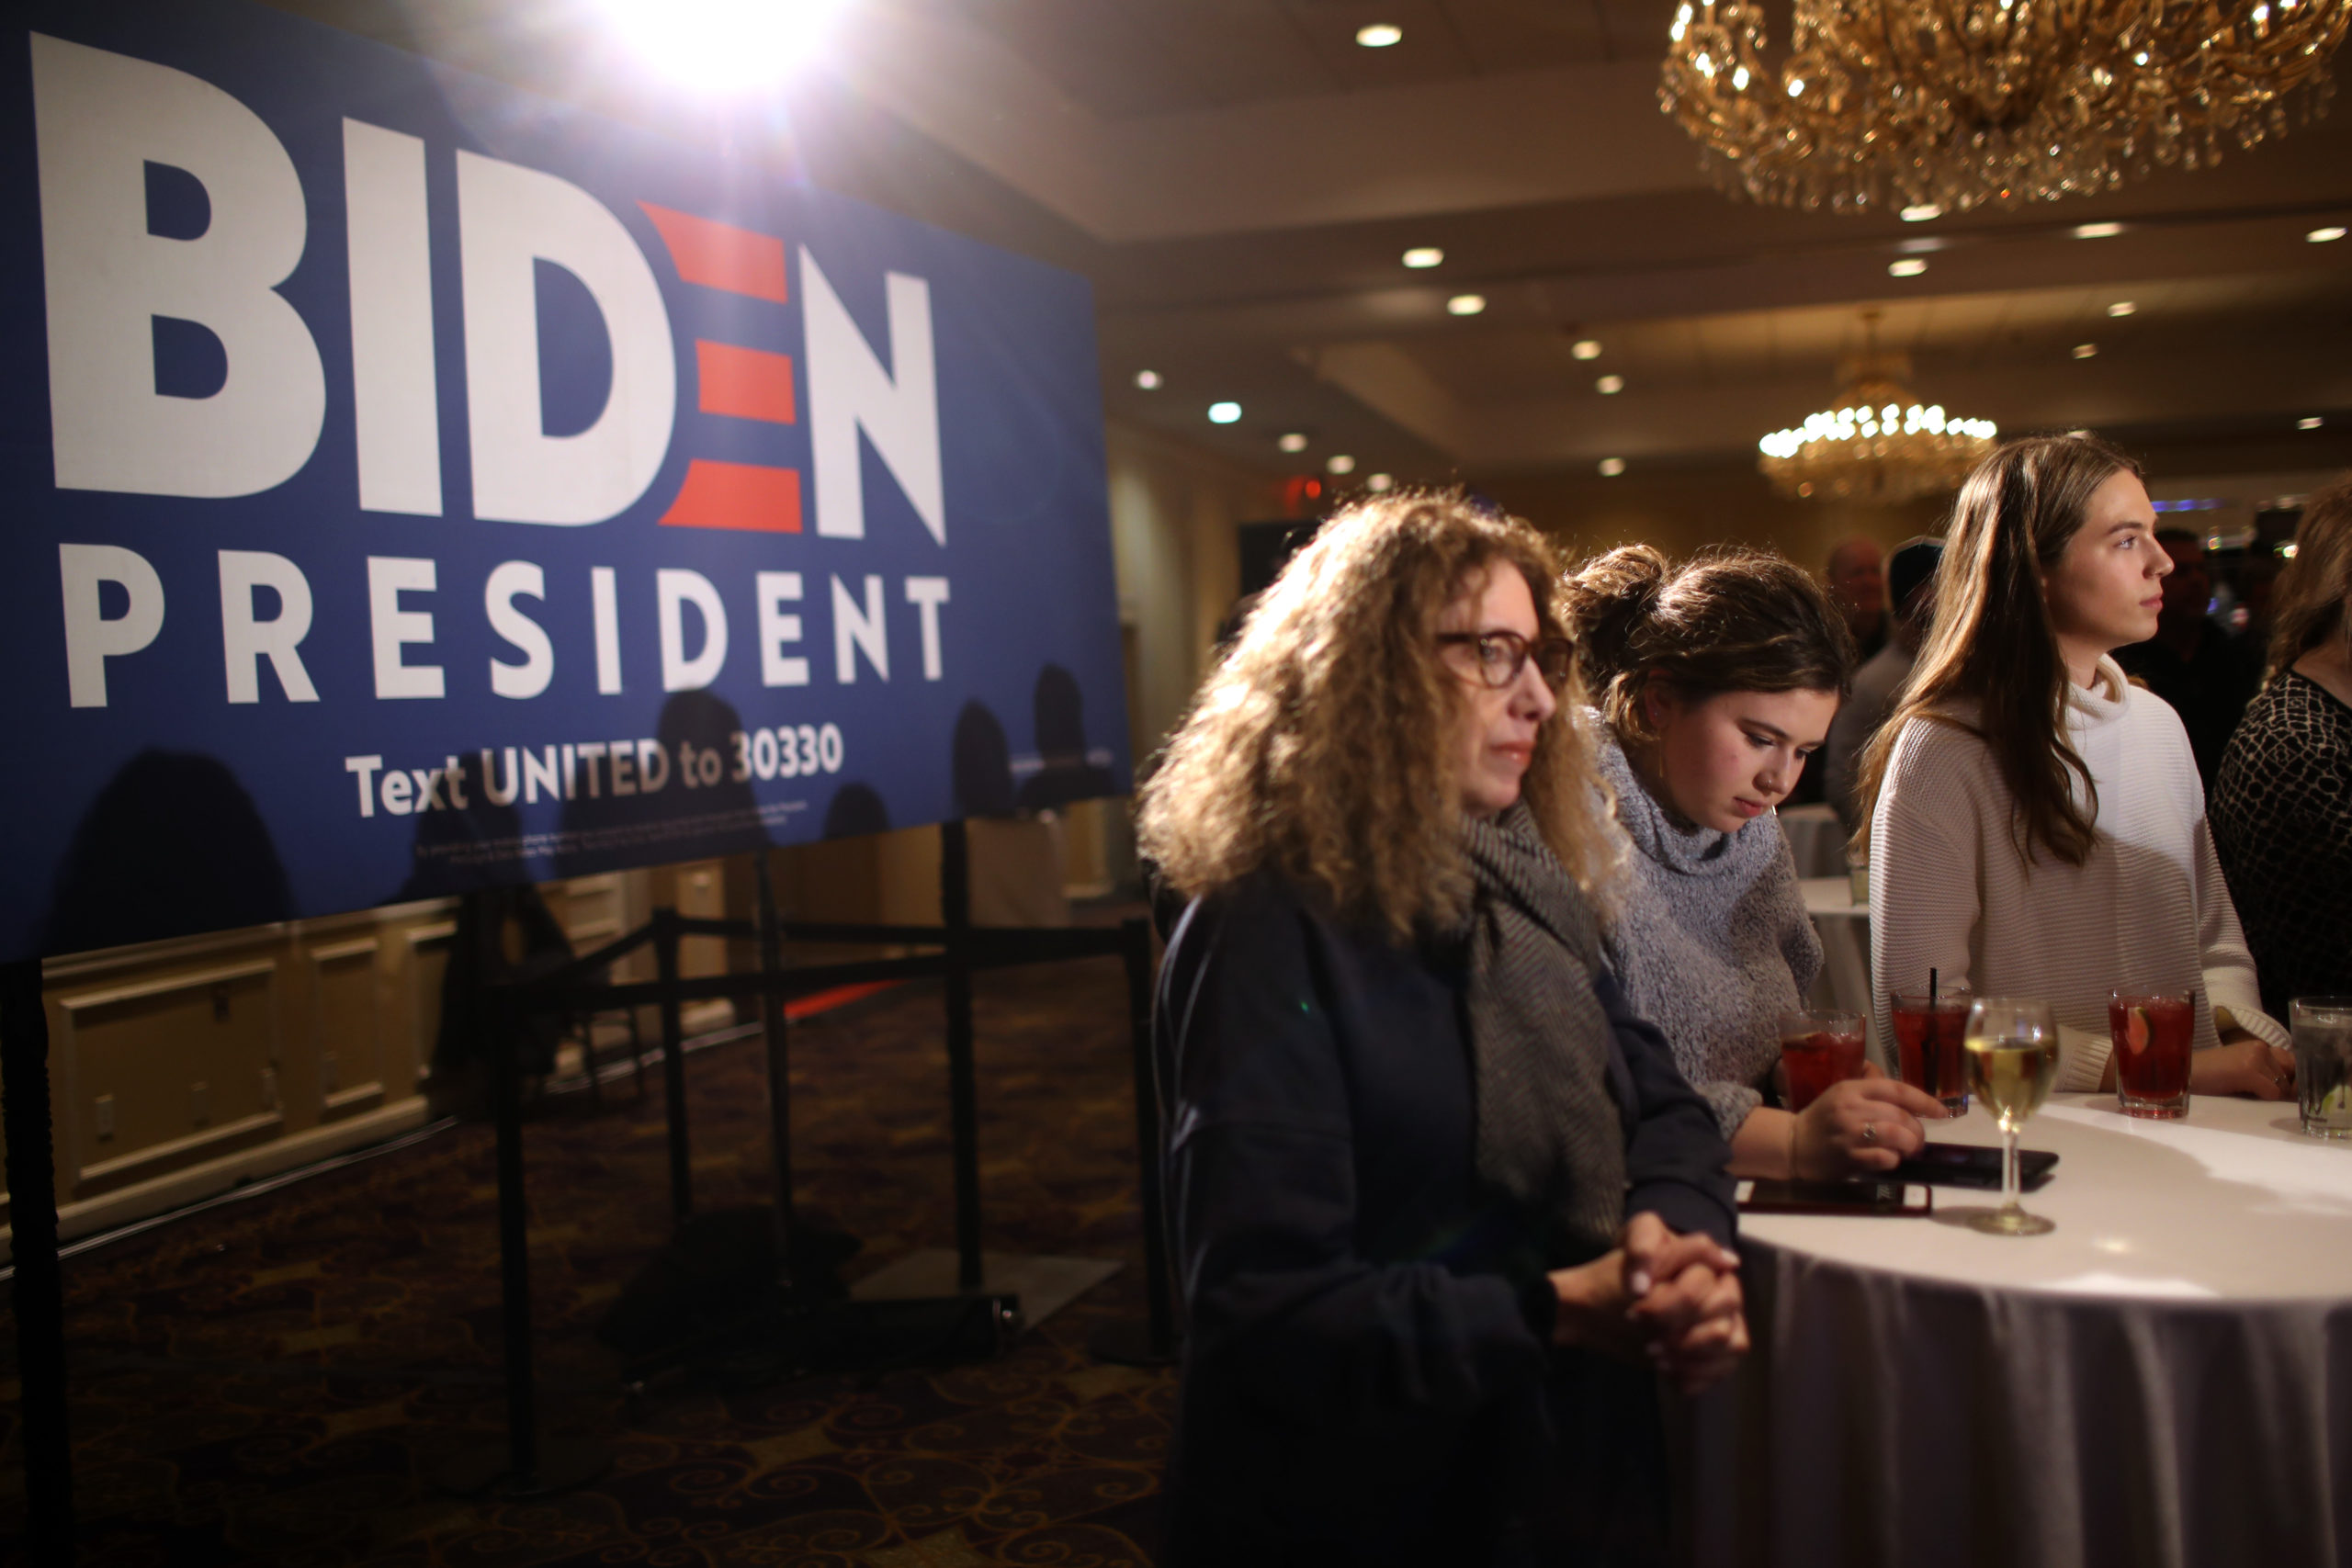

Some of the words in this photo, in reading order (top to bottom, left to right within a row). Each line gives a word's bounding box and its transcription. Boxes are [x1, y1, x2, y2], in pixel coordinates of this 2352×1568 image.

[30, 31, 946, 547] BIDEN
[58, 543, 950, 707] PRESIDENT
[345, 754, 467, 818] Text
[482, 739, 669, 807] UNITED
[680, 740, 722, 788] to
[731, 723, 843, 783] 30330
